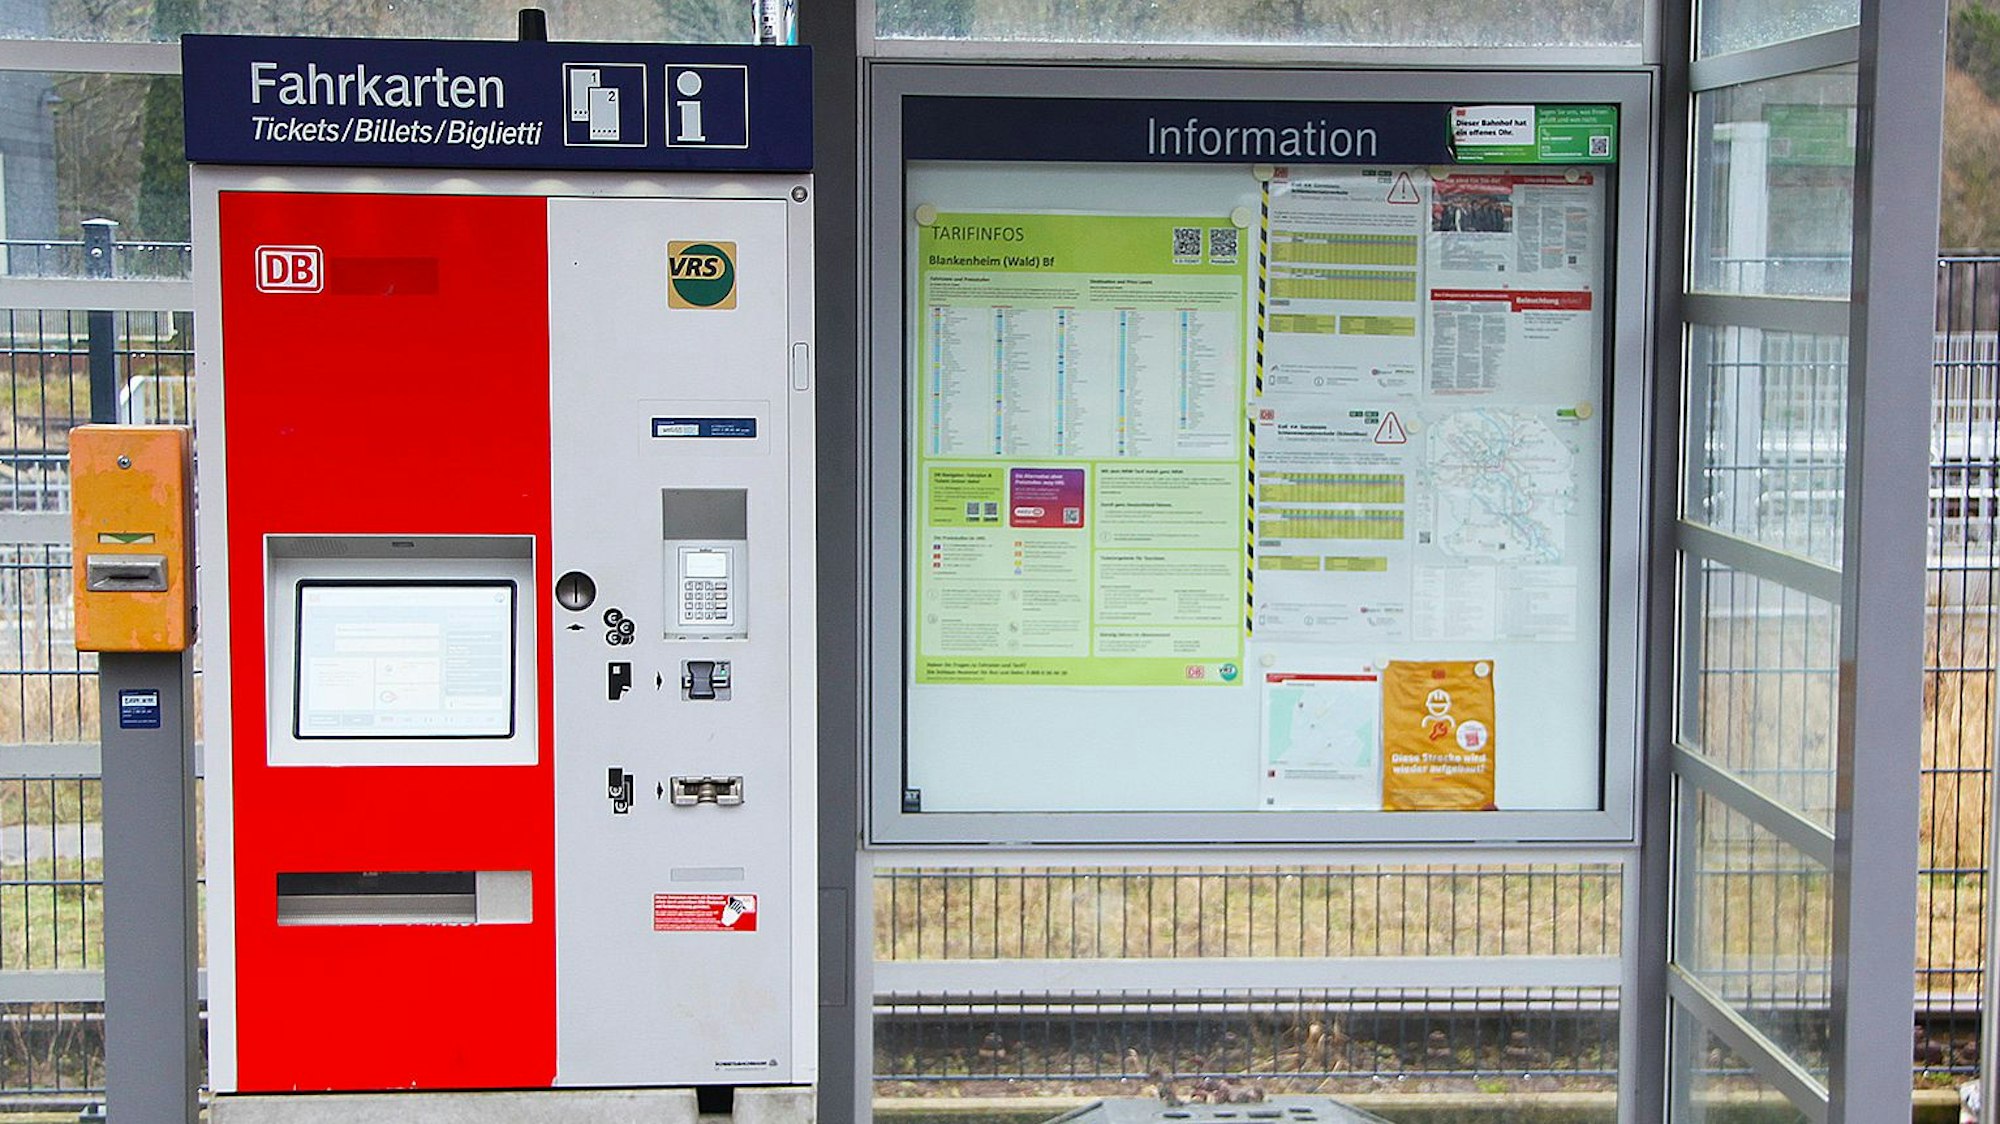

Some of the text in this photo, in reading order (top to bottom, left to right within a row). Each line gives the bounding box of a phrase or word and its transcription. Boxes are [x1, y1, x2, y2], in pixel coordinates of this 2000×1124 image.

[250, 61, 504, 109] Fahrkarten
[1455, 128, 1467, 136] ein
[1456, 119, 1527, 127] Dieser Bahnhof hat
[1147, 117, 1378, 157] Information
[931, 226, 1024, 242] TARIFINFOS
[265, 254, 314, 284] DB
[668, 257, 719, 277] VRS
[929, 255, 1055, 268] Blankenheim (Wald) Bf
